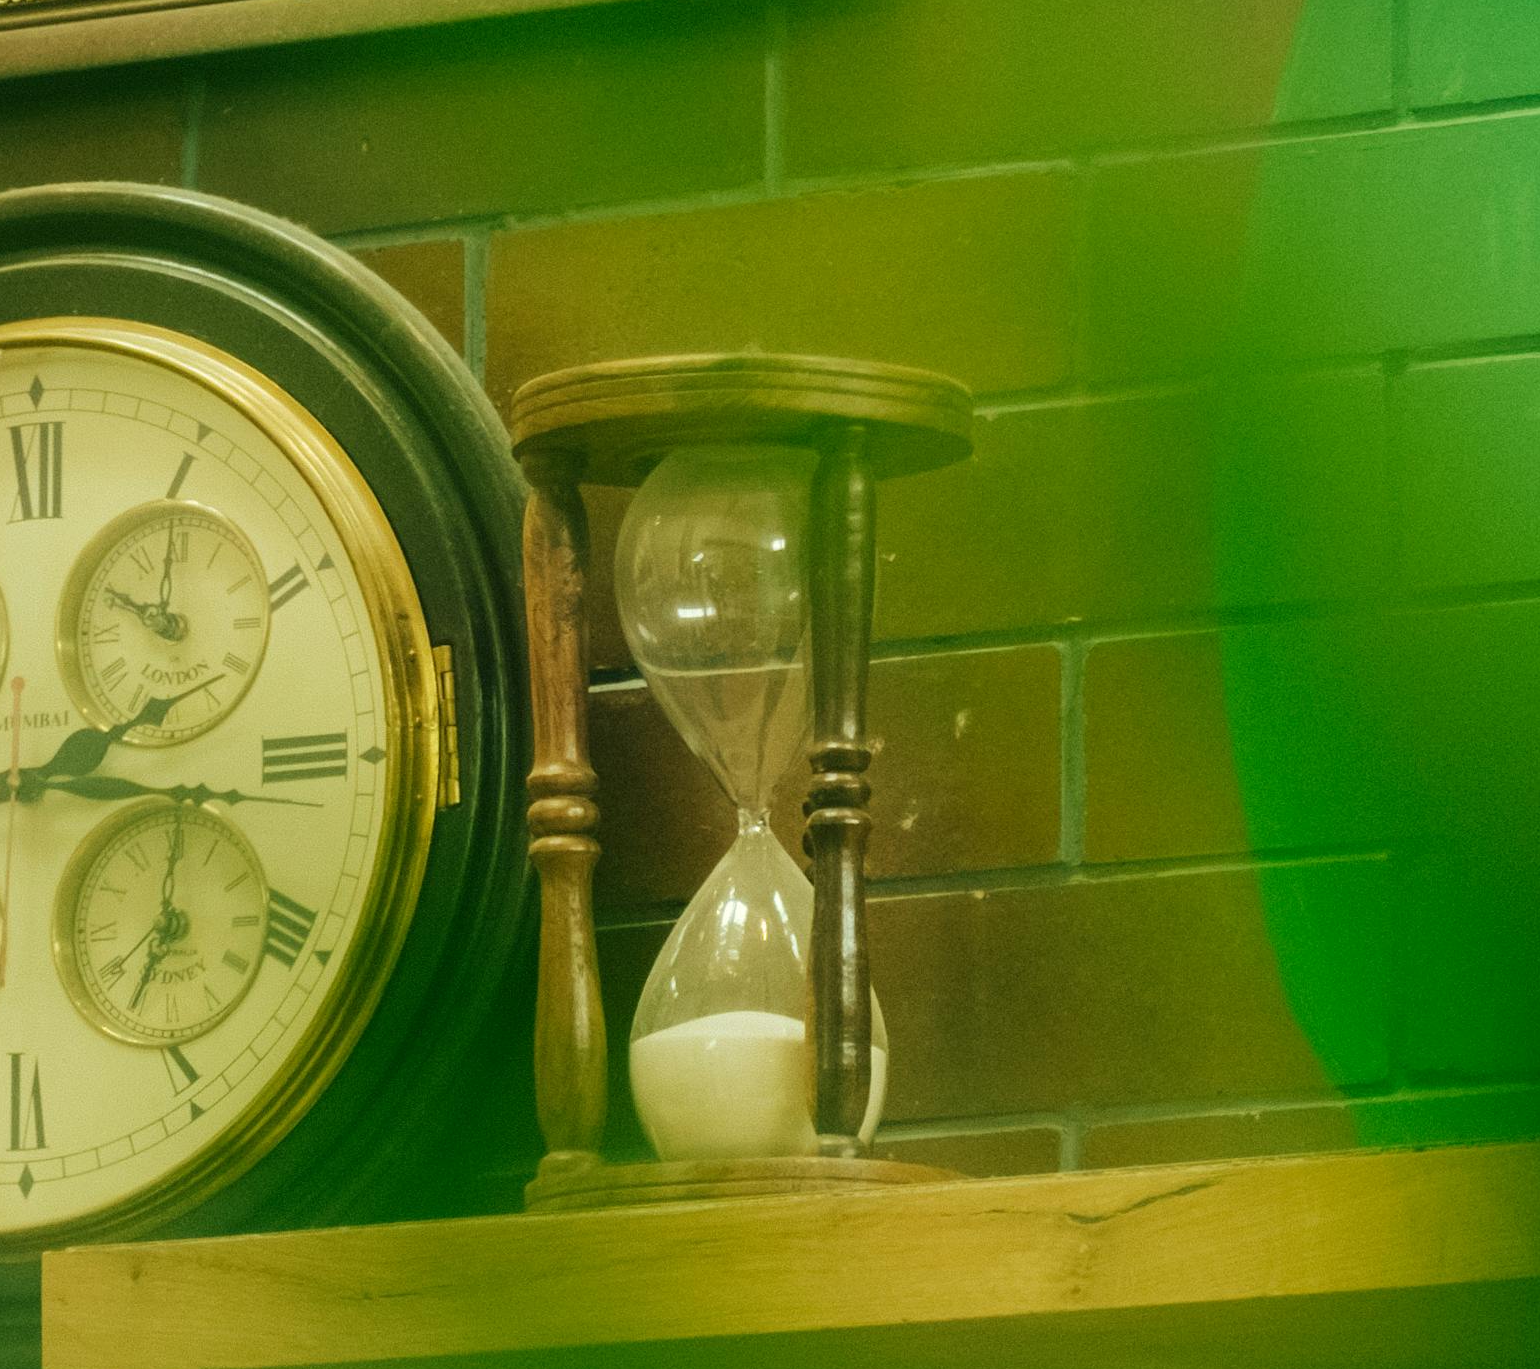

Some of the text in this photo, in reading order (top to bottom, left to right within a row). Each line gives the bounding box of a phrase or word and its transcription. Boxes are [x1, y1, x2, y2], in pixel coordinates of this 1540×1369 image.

[6, 421, 65, 525] XII
[141, 662, 210, 686] LONDON
[261, 727, 349, 788] III
[140, 958, 206, 984] YDNEY
